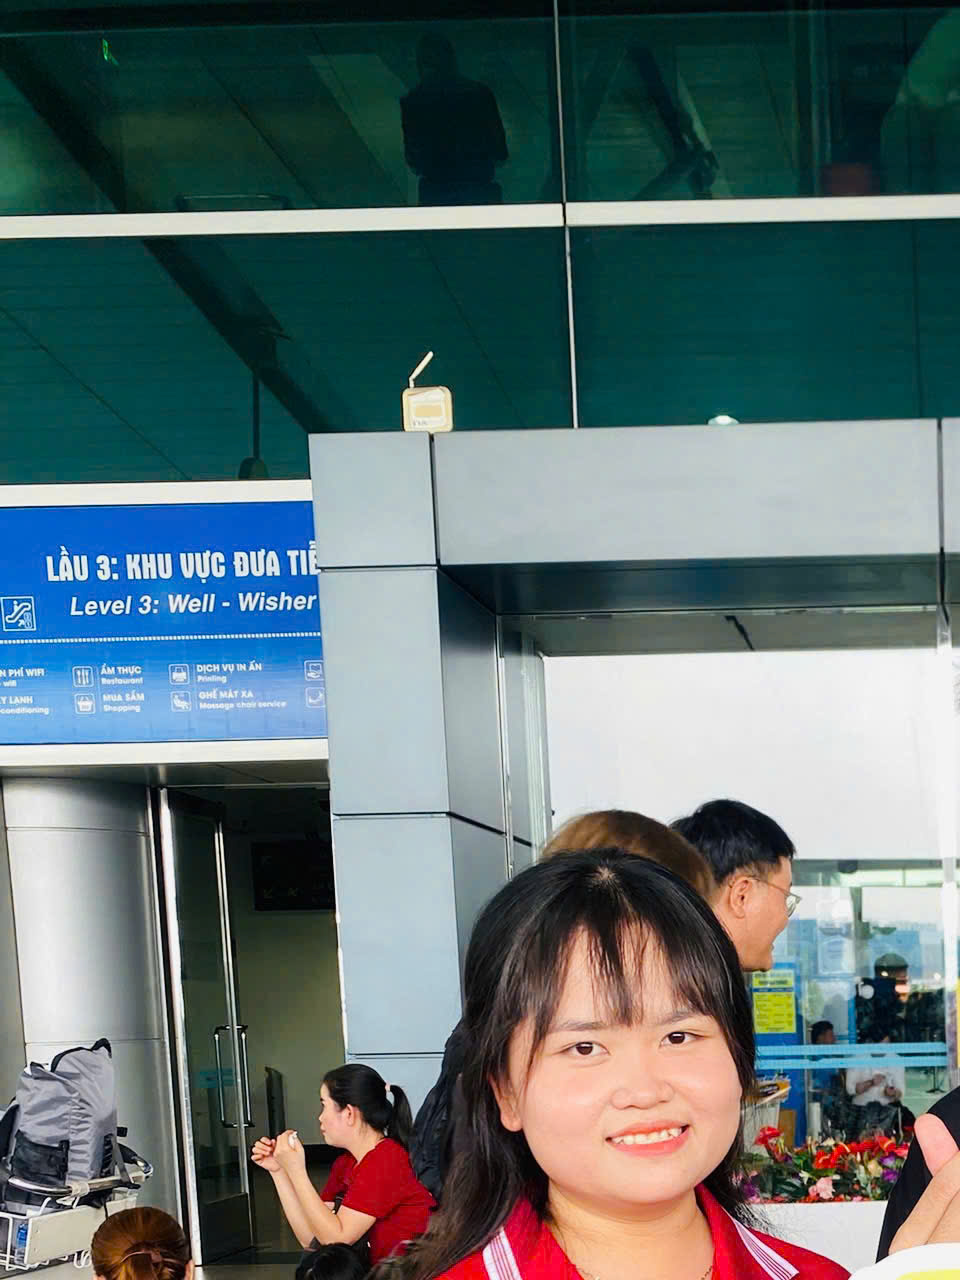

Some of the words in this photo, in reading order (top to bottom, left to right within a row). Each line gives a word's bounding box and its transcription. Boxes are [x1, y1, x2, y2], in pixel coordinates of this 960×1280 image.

[46, 546, 88, 581] LẦU
[96, 557, 119, 581] 3:
[126, 553, 172, 580] KHU
[180, 552, 226, 583] VỰC
[233, 549, 280, 577] ĐƯA
[70, 595, 132, 616] Level
[138, 595, 159, 615] 3:
[168, 593, 215, 613] Well
[238, 592, 317, 612] Wisher
[26, 668, 44, 676] WIFI
[101, 677, 143, 685] Restaurant
[197, 675, 227, 683] Printing
